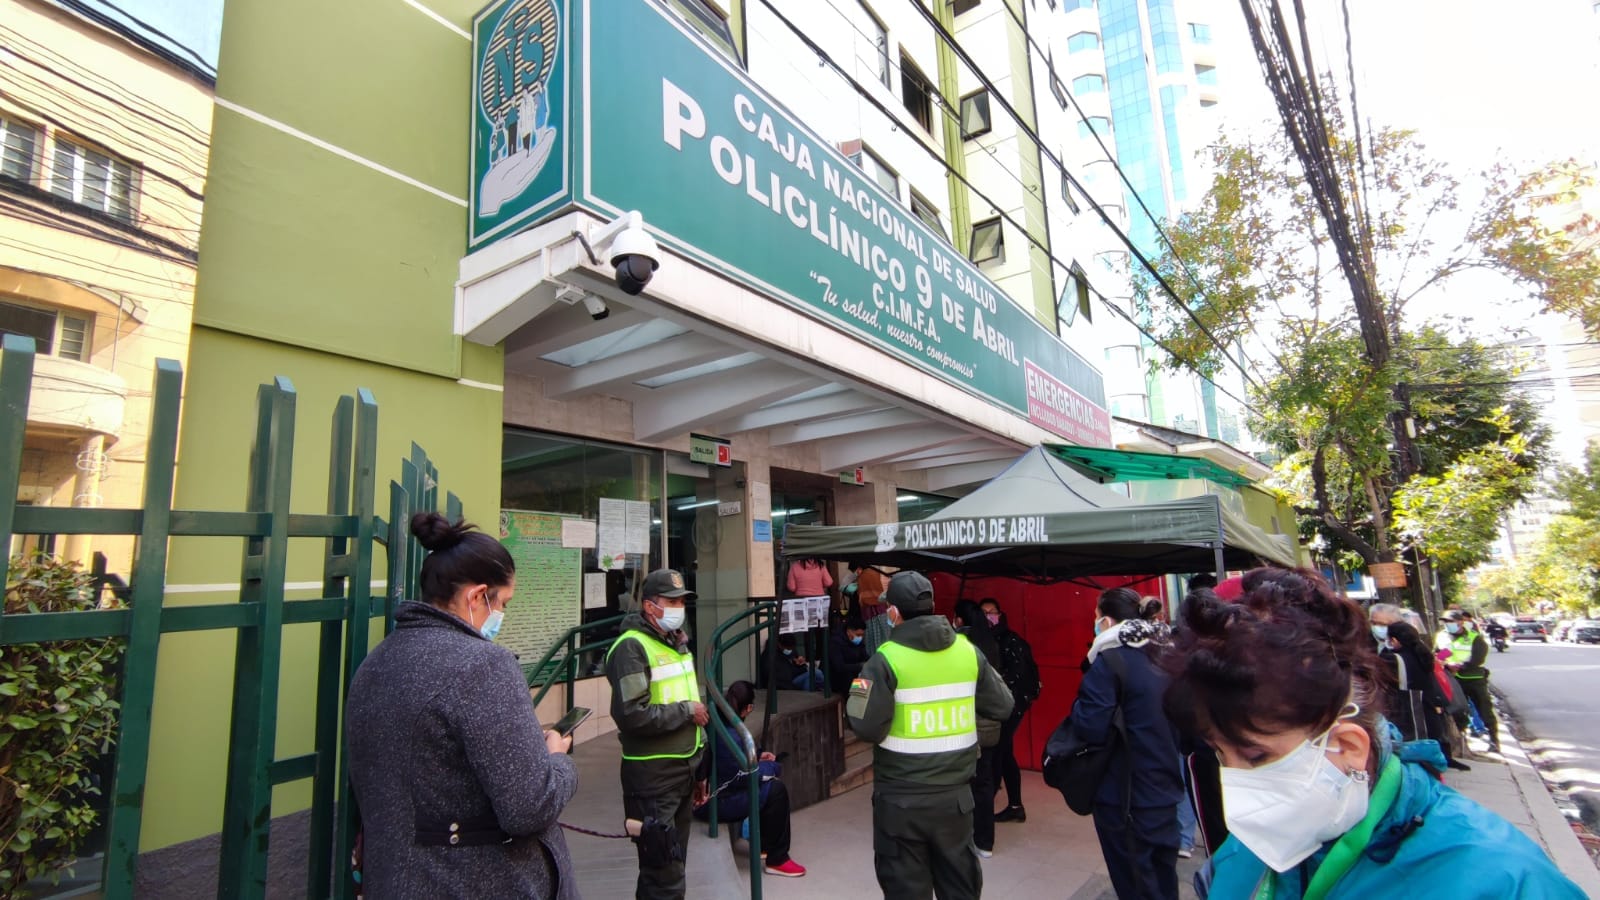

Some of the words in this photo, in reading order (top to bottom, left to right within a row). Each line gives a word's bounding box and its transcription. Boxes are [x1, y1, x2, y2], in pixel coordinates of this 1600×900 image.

[662, 77, 906, 292] POLICLÍNICO
[915, 265, 933, 309] 9
[941, 293, 966, 332] DE
[972, 307, 1020, 366] ABRIL
[734, 94, 816, 180] CAJA
[823, 160, 928, 264] NACIONAL
[932, 248, 953, 282] DE
[955, 268, 997, 314] SALUD
[842, 297, 882, 331] salud,
[886, 323, 924, 351] nuestro
[872, 282, 941, 343] C.I.M.F.A.
[1027, 368, 1094, 430] EMERGENCIAS
[694, 446, 713, 455] SALIDA
[904, 520, 976, 548] POLICLINICO
[978, 518, 986, 544] 9
[989, 518, 1006, 543] DE
[1008, 516, 1049, 543] ABRIL
[911, 704, 975, 733] POLIC
